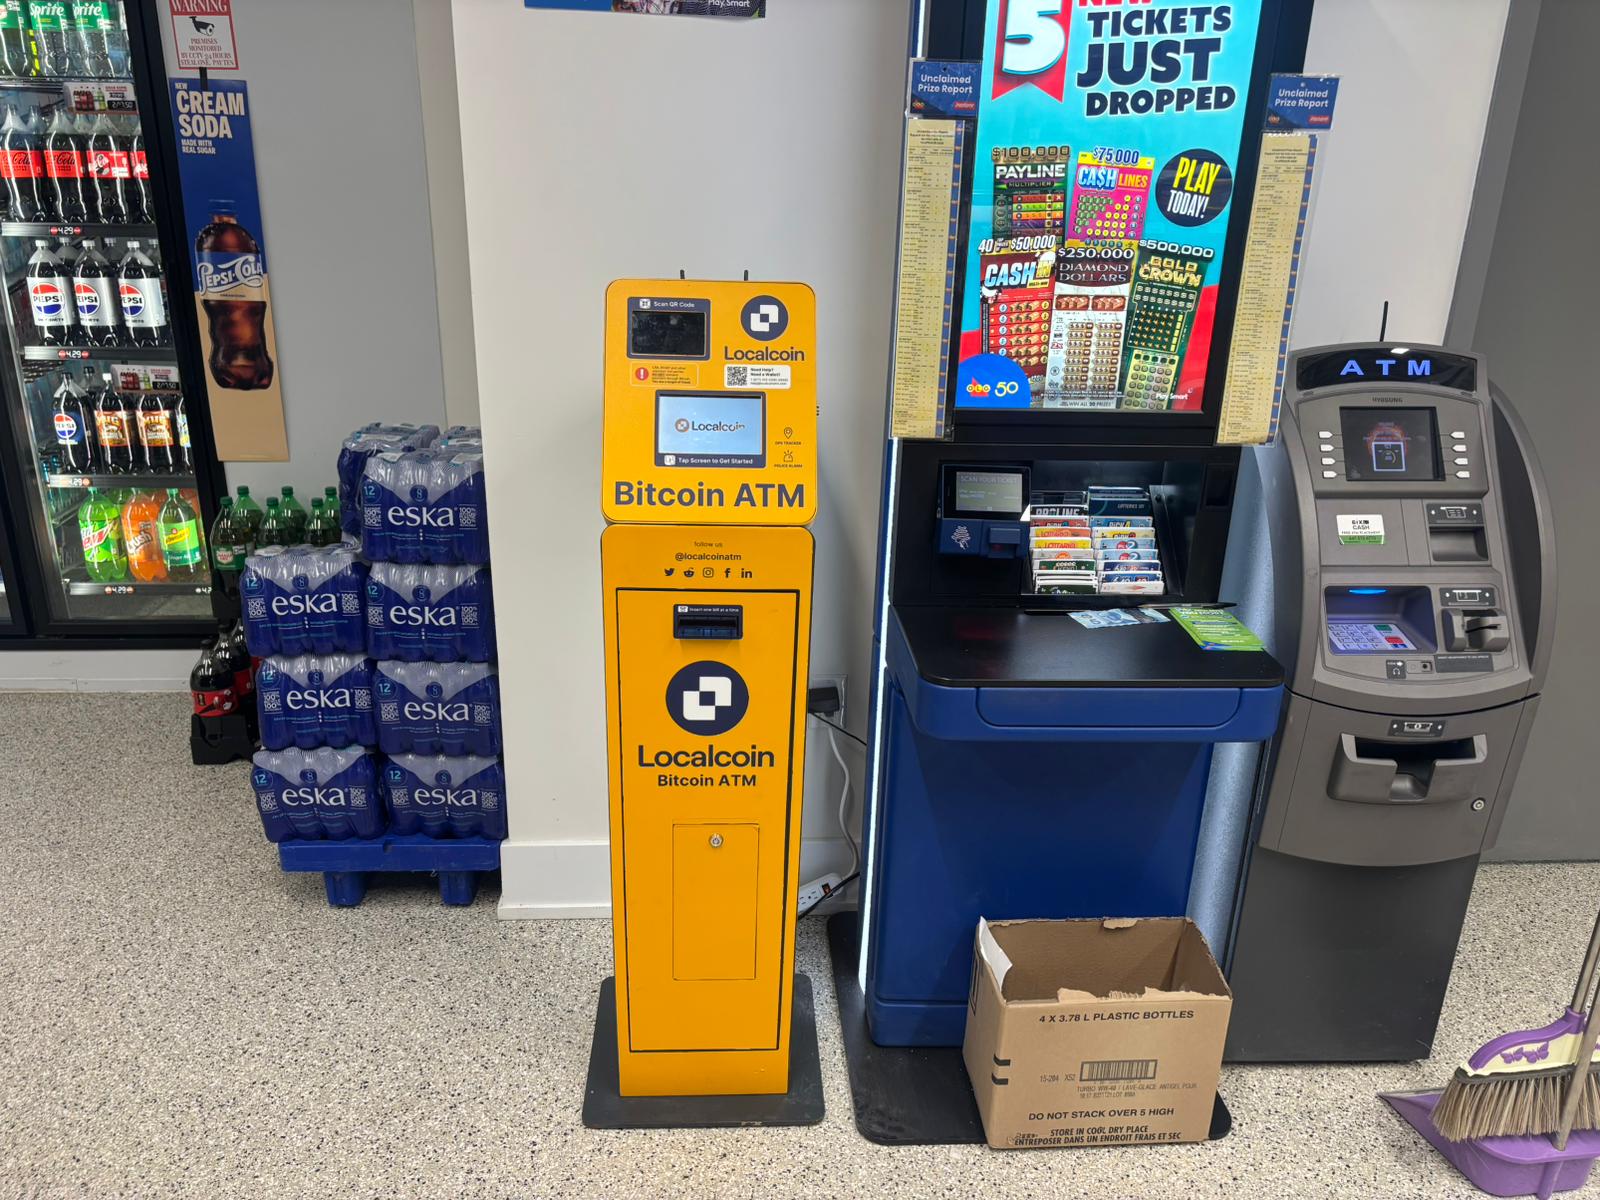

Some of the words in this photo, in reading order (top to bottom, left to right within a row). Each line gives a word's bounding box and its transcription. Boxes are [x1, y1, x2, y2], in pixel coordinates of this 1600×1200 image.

[30, 3, 65, 18] Sprite
[72, 3, 102, 16] prite
[171, 0, 228, 12] WARNING
[1087, 6, 1232, 38] TICKETS
[1077, 37, 1222, 87] JUST
[921, 74, 971, 84] Unclaimed
[918, 84, 940, 93] Prize
[942, 85, 973, 95] Report
[1278, 88, 1329, 98] Unclaimed
[176, 90, 245, 116] CREAM
[1086, 86, 1236, 117] DROPPED
[1275, 98, 1297, 107] Prize
[1298, 99, 1329, 109] Report
[178, 114, 233, 139] SODA
[181, 138, 197, 146] MADE
[198, 139, 213, 147] WITH
[182, 146, 196, 154] REAL
[197, 146, 216, 154] SUGAR
[992, 146, 1070, 161] $100,000
[1093, 147, 1140, 165] $75,000
[995, 164, 1066, 180] PAYLINE
[1172, 157, 1221, 195] PLAY
[1118, 173, 1148, 188] LINES
[1167, 189, 1209, 219] TODAY!
[58, 227, 74, 235] 4.29
[978, 238, 994, 253] 40
[1011, 235, 1056, 251] $50,000
[1138, 239, 1214, 258] $500,000
[1057, 248, 1133, 260] $250,000
[1059, 263, 1129, 273] DIAMOND
[1150, 256, 1198, 273] GOLD
[984, 262, 1037, 288] CASH
[1059, 273, 1127, 284] DOLLARS
[1139, 263, 1202, 287] CROWN
[653, 300, 669, 308] Scan
[65, 350, 81, 358] 4.29
[724, 346, 805, 362] Localcoin
[1340, 360, 1431, 376] ATM
[994, 381, 1019, 397] 50
[1155, 393, 1168, 401] Play
[691, 420, 746, 432] Localcoin
[364, 485, 376, 496] 12
[615, 481, 725, 506] Bitcoin
[733, 483, 805, 508] ATM
[387, 506, 455, 527] eska
[675, 552, 742, 561] @localcoinatm
[246, 577, 258, 588] 12
[368, 585, 379, 595] 12
[272, 593, 338, 616] eska
[389, 605, 457, 626] eska
[261, 671, 273, 681] 12
[378, 683, 391, 693] 12
[286, 688, 351, 710] eska
[404, 701, 469, 722] eska
[638, 744, 775, 768] Localcoin
[254, 774, 267, 785] 12
[390, 770, 401, 780] 12
[657, 774, 714, 787] Bitcoin
[718, 774, 757, 787] ATM
[282, 787, 346, 806] eska
[414, 788, 477, 807] eska
[1039, 1015, 1046, 1023] 4
[1059, 1014, 1081, 1022] 3.78
[1083, 1013, 1091, 1021] L
[1093, 1011, 1140, 1021] PLASTIC
[1142, 1010, 1195, 1020] BOTTLES
[1122, 1083, 1156, 1091] LAVE-GLACE
[1028, 1110, 1045, 1121] DO
[1046, 1110, 1069, 1120] NOT
[1070, 1109, 1106, 1119] STACK
[1108, 1108, 1138, 1118] OVER
[1139, 1108, 1147, 1117] 5
[1148, 1106, 1175, 1117] HIGH
[1014, 1135, 1062, 1146] ENTREPOSER
[1063, 1135, 1085, 1144] DANS
[1086, 1135, 1098, 1143] UN
[1099, 1134, 1133, 1143] ENDROIT
[1134, 1132, 1156, 1141] FRAIS
[1157, 1132, 1167, 1140] ET
[1168, 1131, 1182, 1140] SEC
[1050, 1128, 1074, 1137] STORE
[1075, 1128, 1085, 1136] IN
[1086, 1126, 1106, 1135] COOL
[1108, 1126, 1124, 1134] DRY
[1125, 1125, 1149, 1133] PLACE
